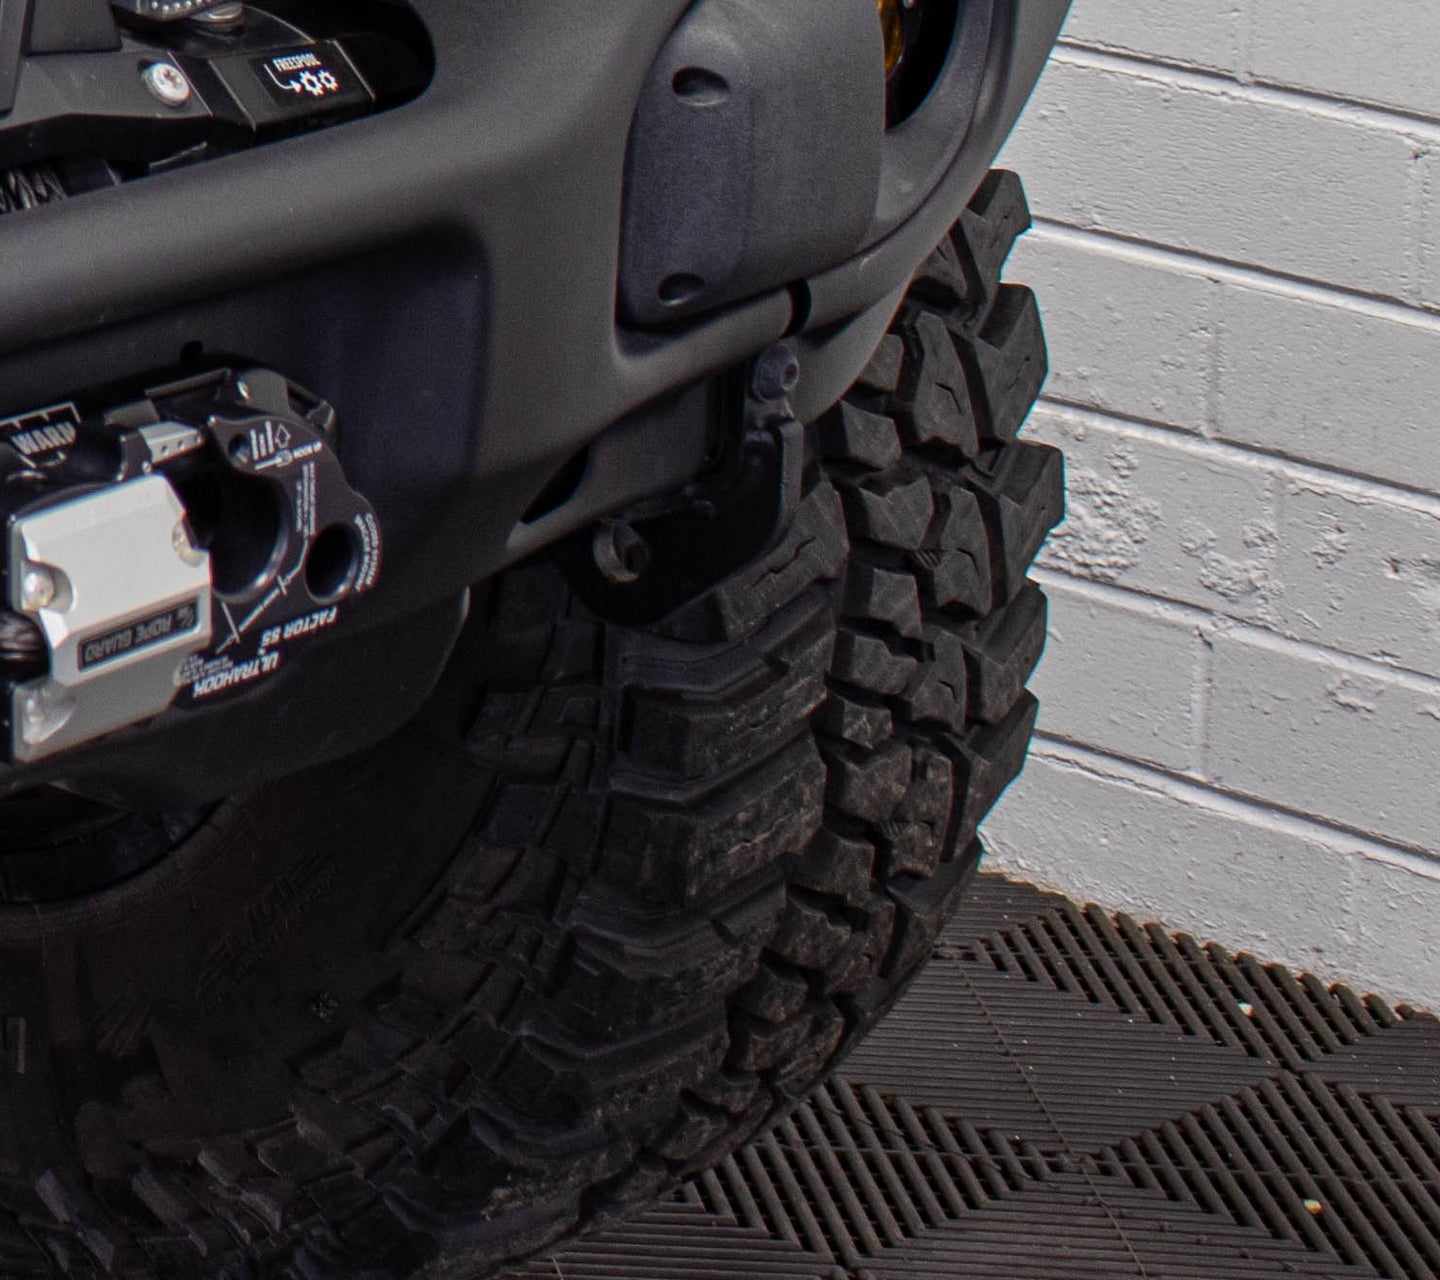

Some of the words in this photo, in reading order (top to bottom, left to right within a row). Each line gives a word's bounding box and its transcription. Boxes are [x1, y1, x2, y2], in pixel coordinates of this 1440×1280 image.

[271, 52, 321, 73] FREESPOOL
[135, 611, 173, 638] ROPE
[283, 606, 338, 639] FACTOR
[83, 628, 133, 662] GUARD
[193, 651, 279, 699] ULTRAHOOK
